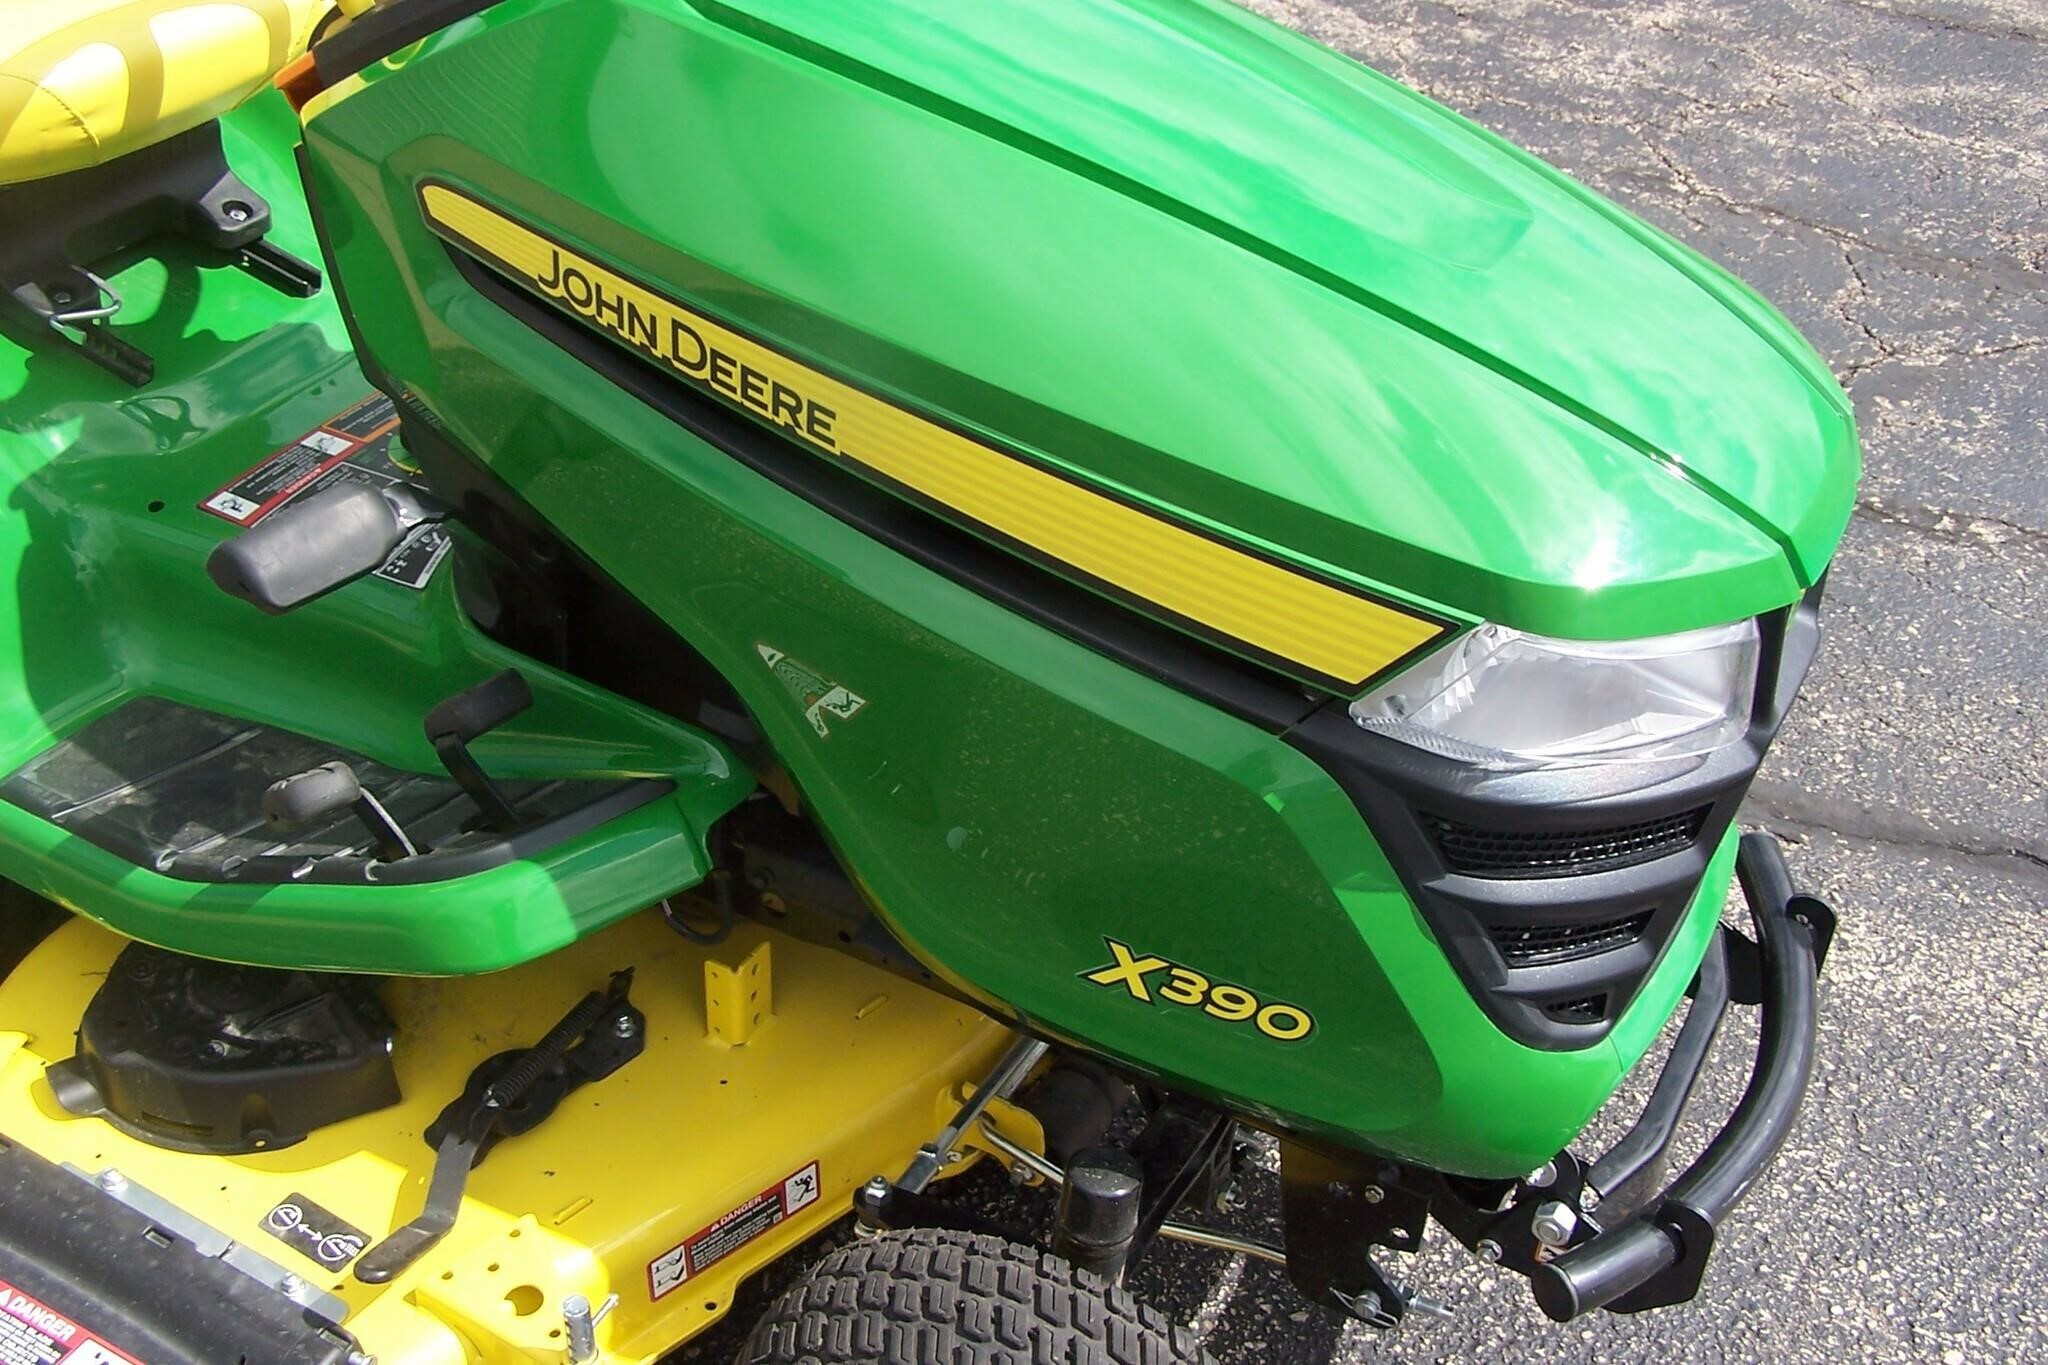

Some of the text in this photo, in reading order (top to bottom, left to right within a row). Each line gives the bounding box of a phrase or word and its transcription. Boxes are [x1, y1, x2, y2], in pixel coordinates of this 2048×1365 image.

[538, 249, 837, 448] JOHN DEERE
[1084, 938, 1313, 1041] X390
[719, 1195, 763, 1226] DANGER
[7, 1295, 77, 1342] DANGER
